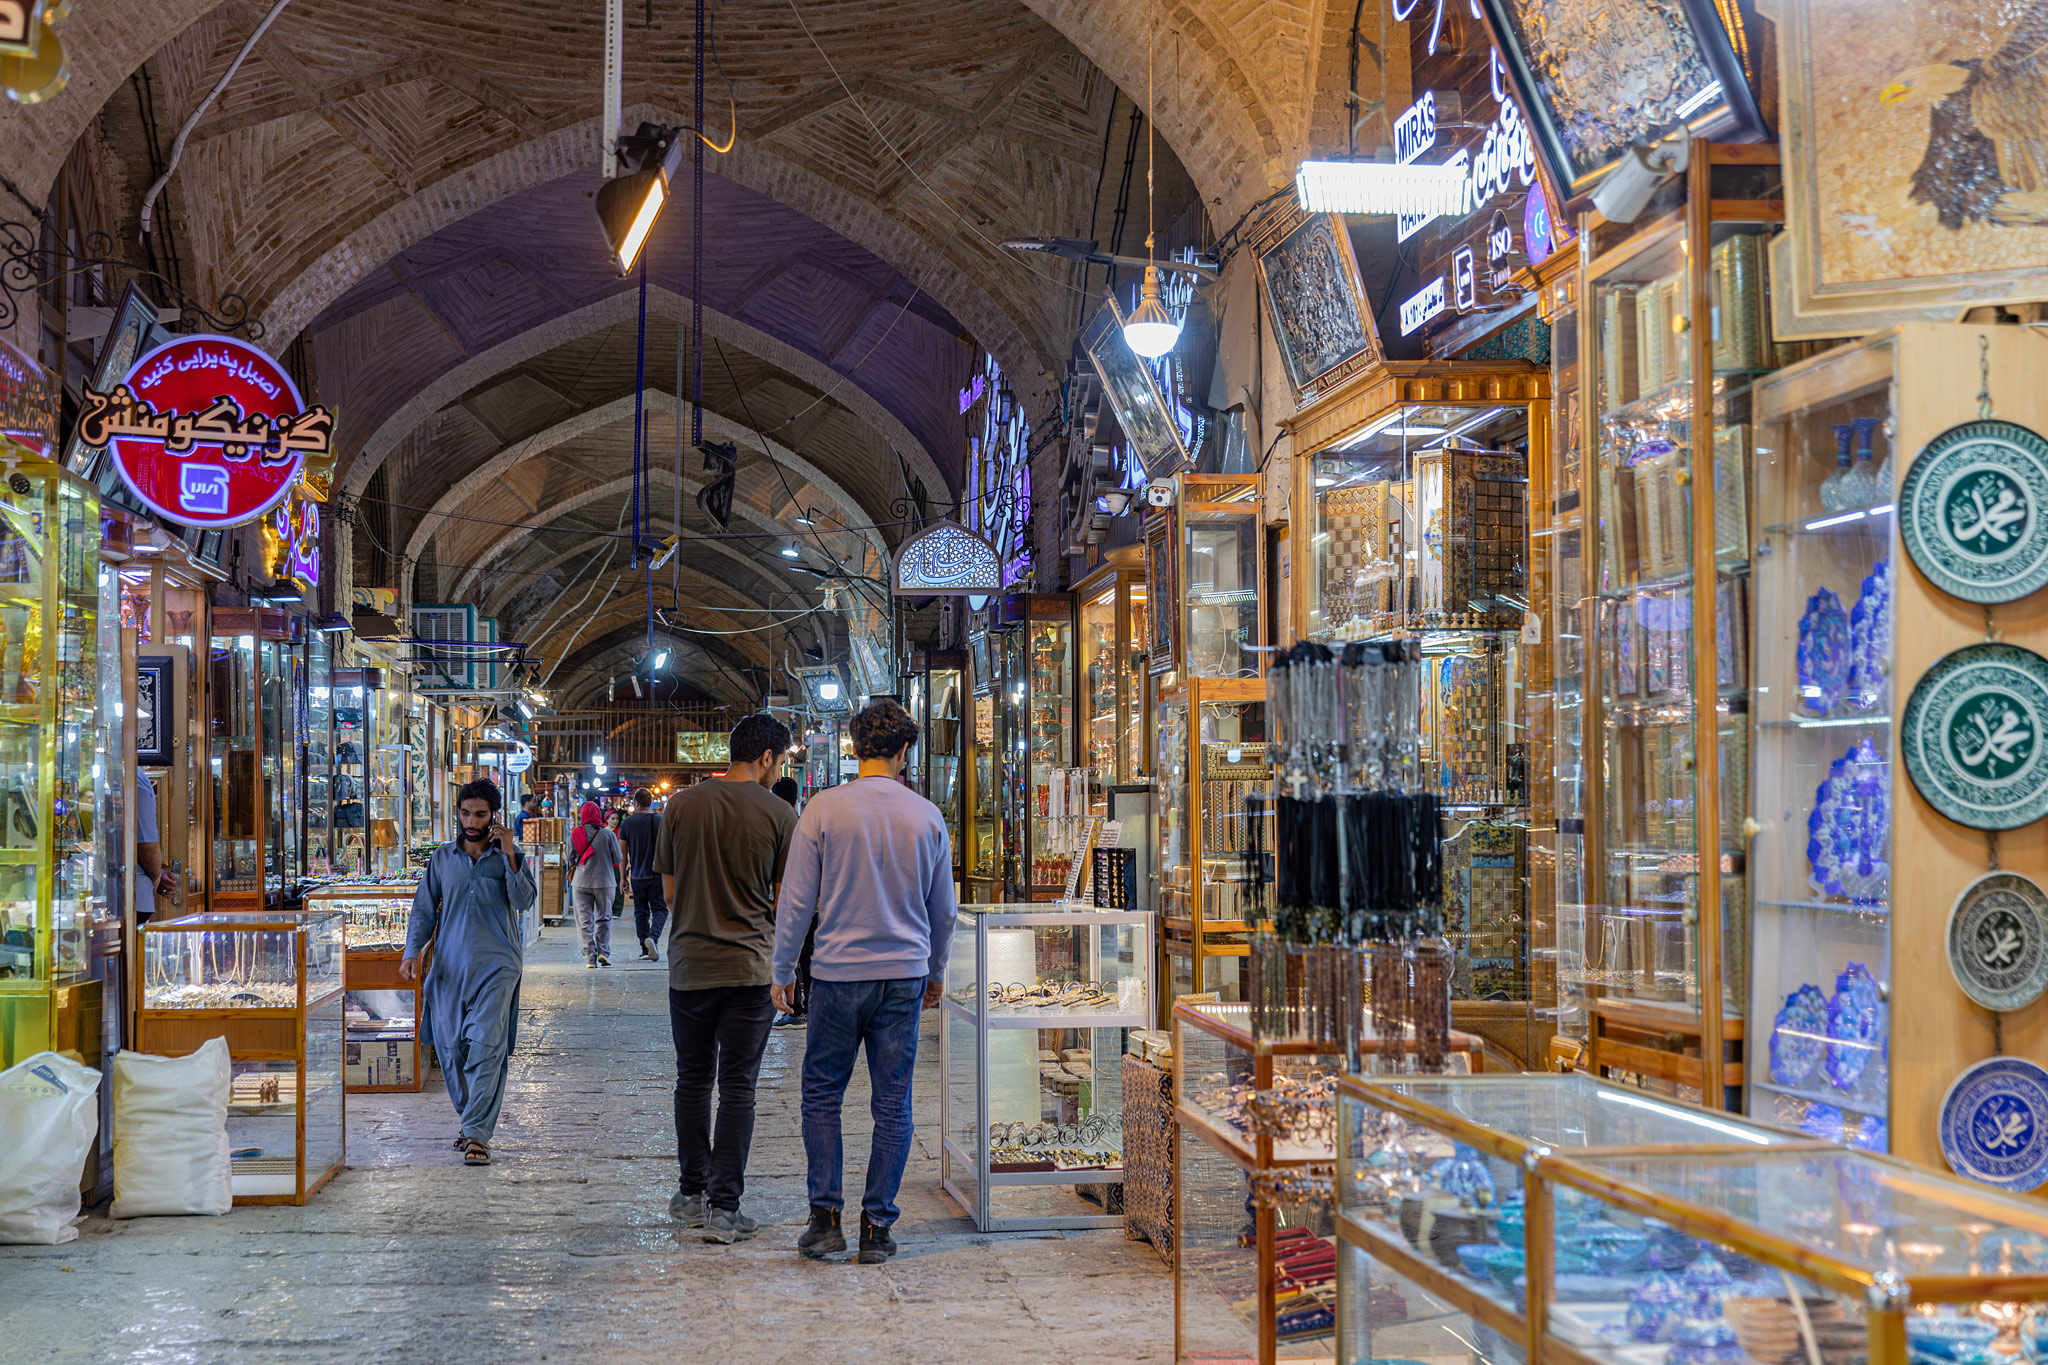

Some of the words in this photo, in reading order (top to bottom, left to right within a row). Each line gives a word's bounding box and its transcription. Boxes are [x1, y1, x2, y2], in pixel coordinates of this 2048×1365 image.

[1397, 99, 1435, 165] MIRAS
[1491, 226, 1513, 261] ISO
[140, 354, 175, 389] کنید
[176, 346, 239, 378] پذیرایی
[236, 360, 282, 400] اصیل
[264, 406, 333, 460] گز
